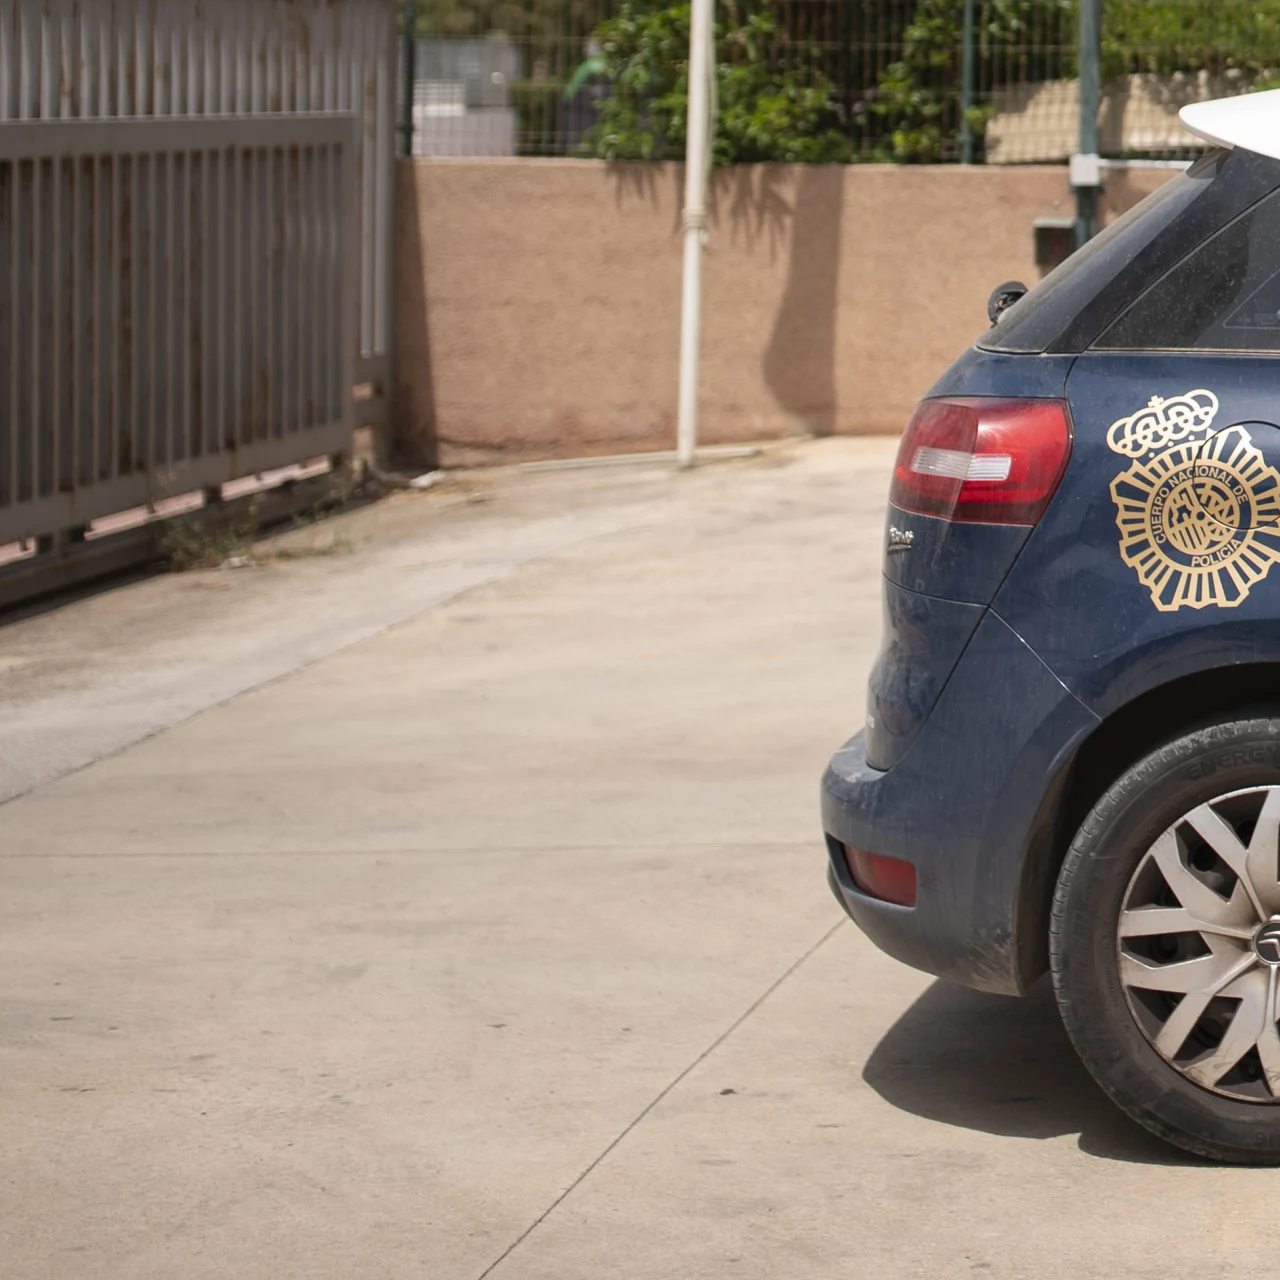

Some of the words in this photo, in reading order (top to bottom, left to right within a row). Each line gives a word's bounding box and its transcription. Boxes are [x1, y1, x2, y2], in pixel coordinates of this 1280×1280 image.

[1151, 487, 1170, 544] CUERPO
[1168, 466, 1233, 488] NACIONAL
[1232, 485, 1249, 505] DE
[1190, 538, 1242, 568] POLICIA
